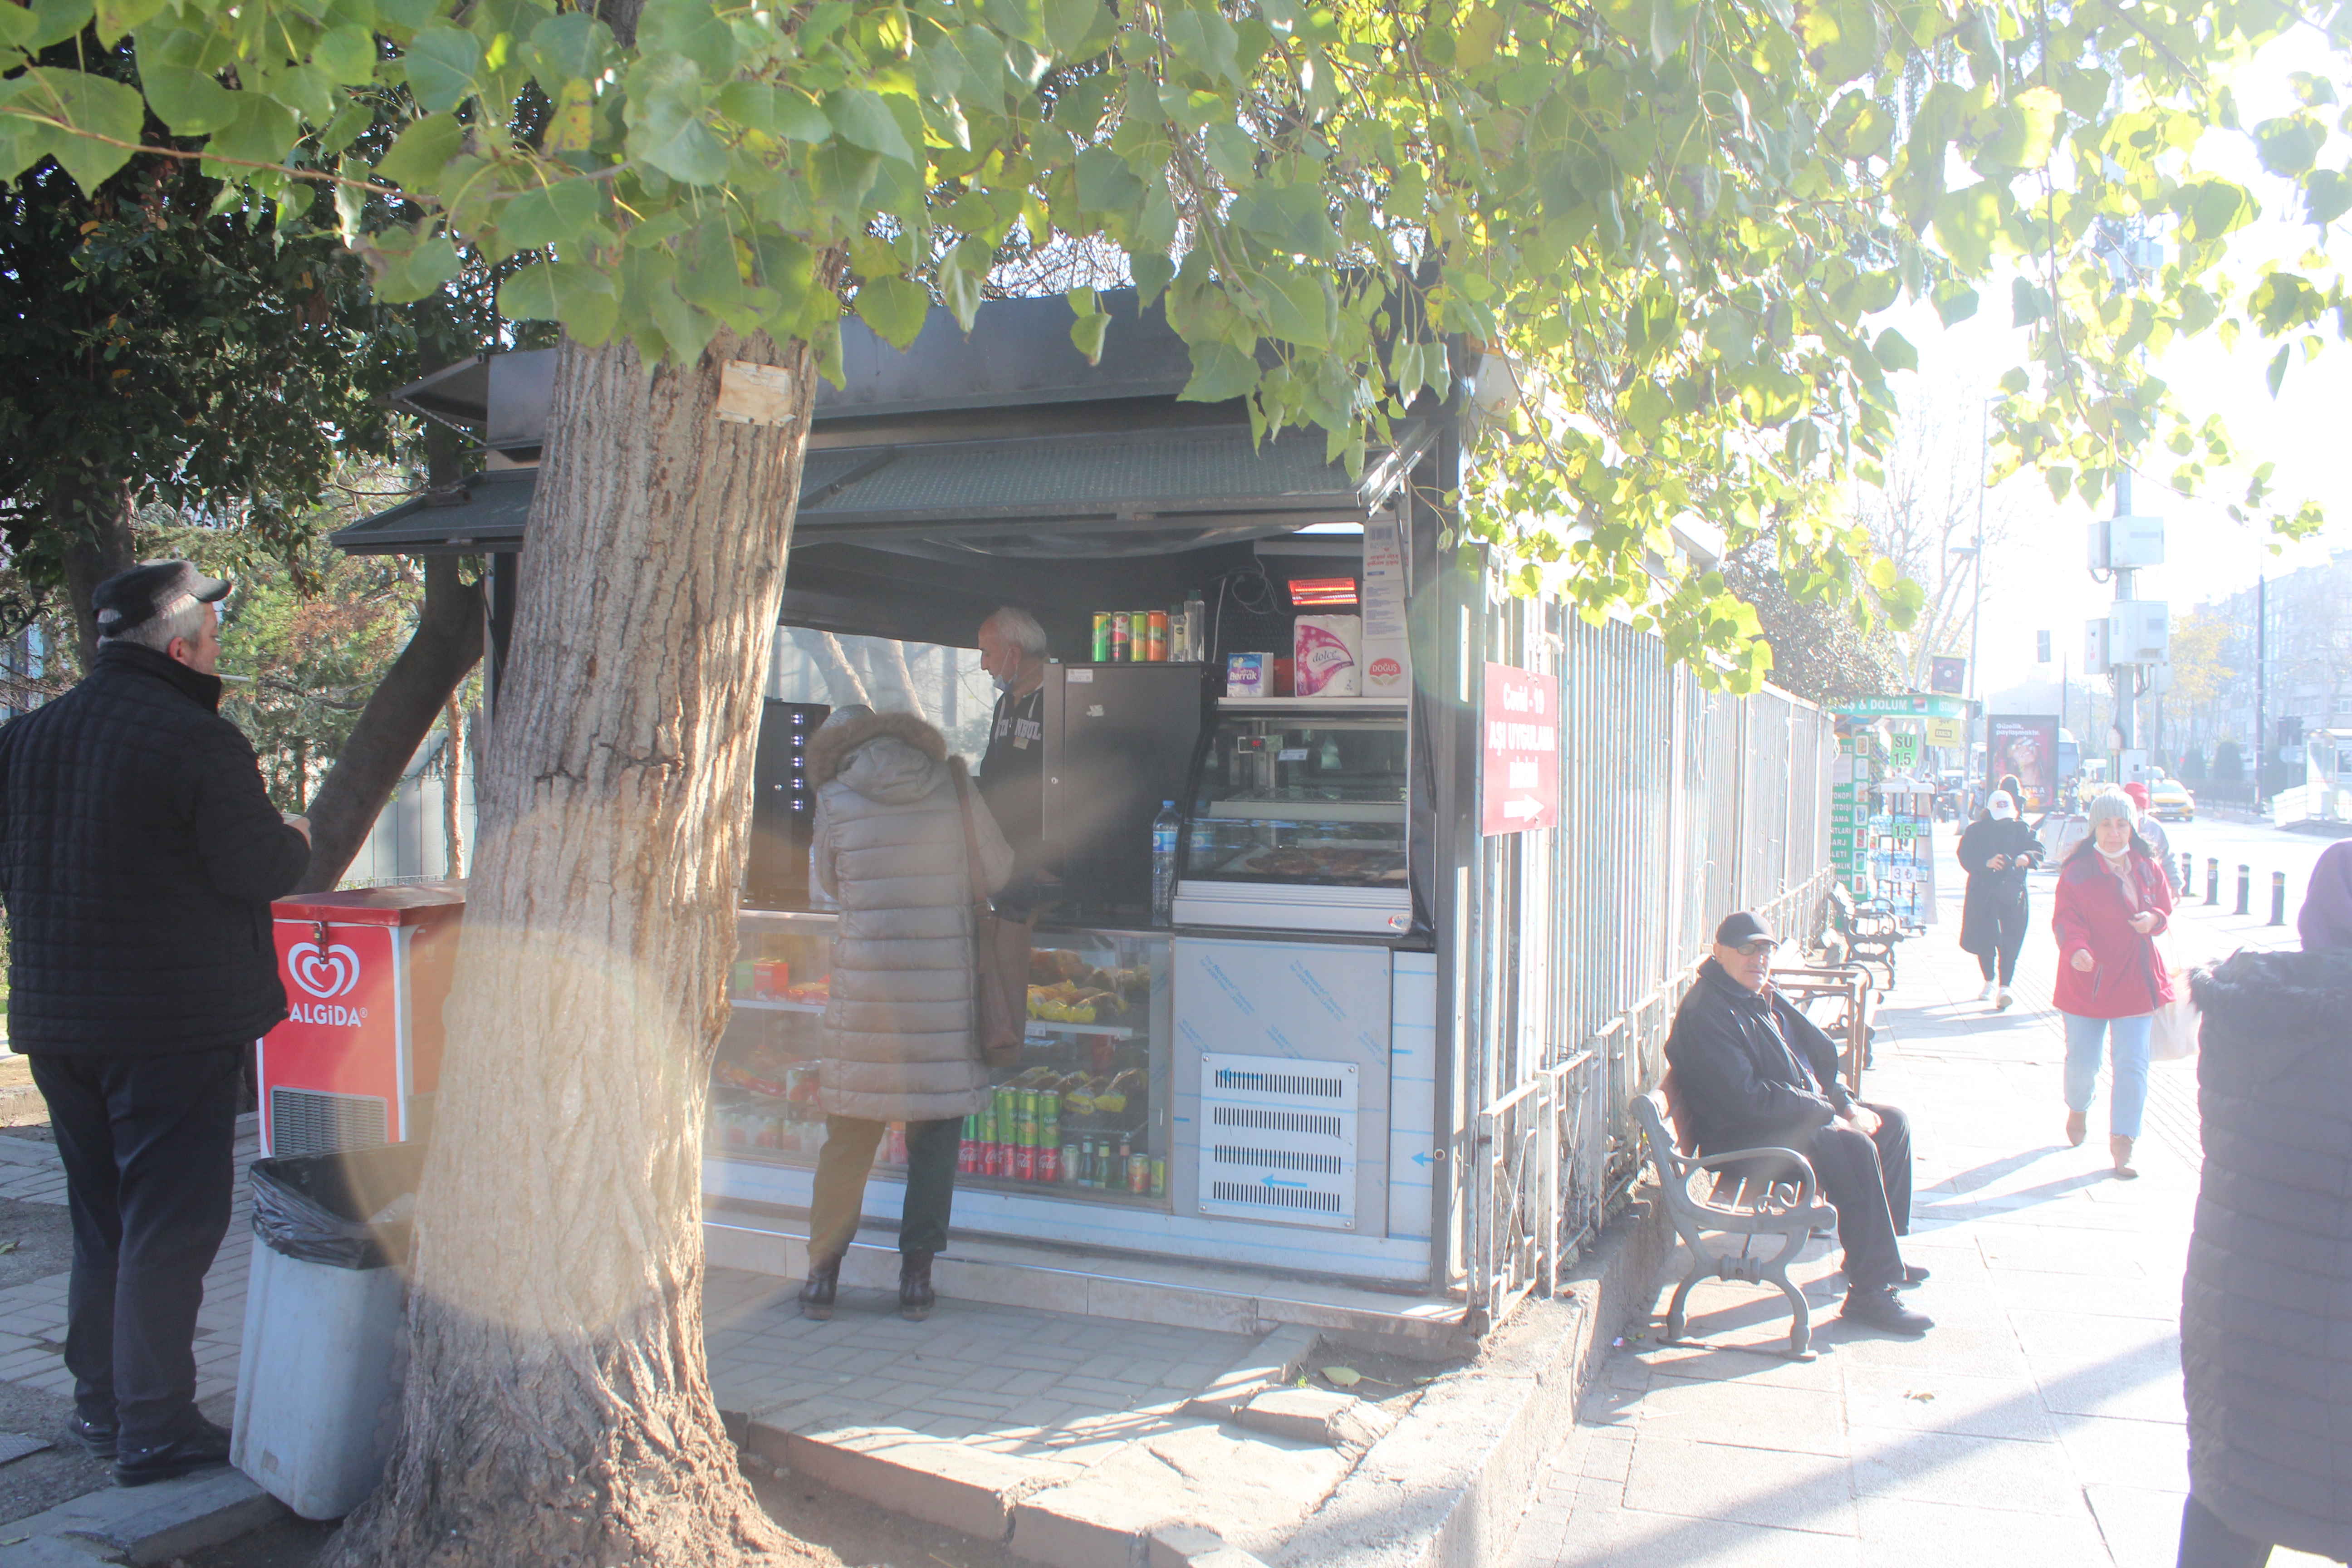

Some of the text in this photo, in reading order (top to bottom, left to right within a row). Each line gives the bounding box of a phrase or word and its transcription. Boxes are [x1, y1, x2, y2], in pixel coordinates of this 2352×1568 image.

[1313, 649, 1337, 662] dolce
[1372, 663, 1397, 672] DOĞUŞ
[1230, 671, 1257, 681] Berrak
[1503, 682, 1528, 713] Covid
[1534, 688, 1545, 715] 19
[1870, 699, 1907, 710] DOLUM
[1489, 721, 1555, 756] AŞI UYGULAMA
[1895, 735, 1913, 749] SU
[1893, 752, 1911, 766] 1.5
[1509, 756, 1539, 789] BİRİMİ
[1894, 825, 1912, 837] 1.5
[1894, 869, 1901, 880] 3
